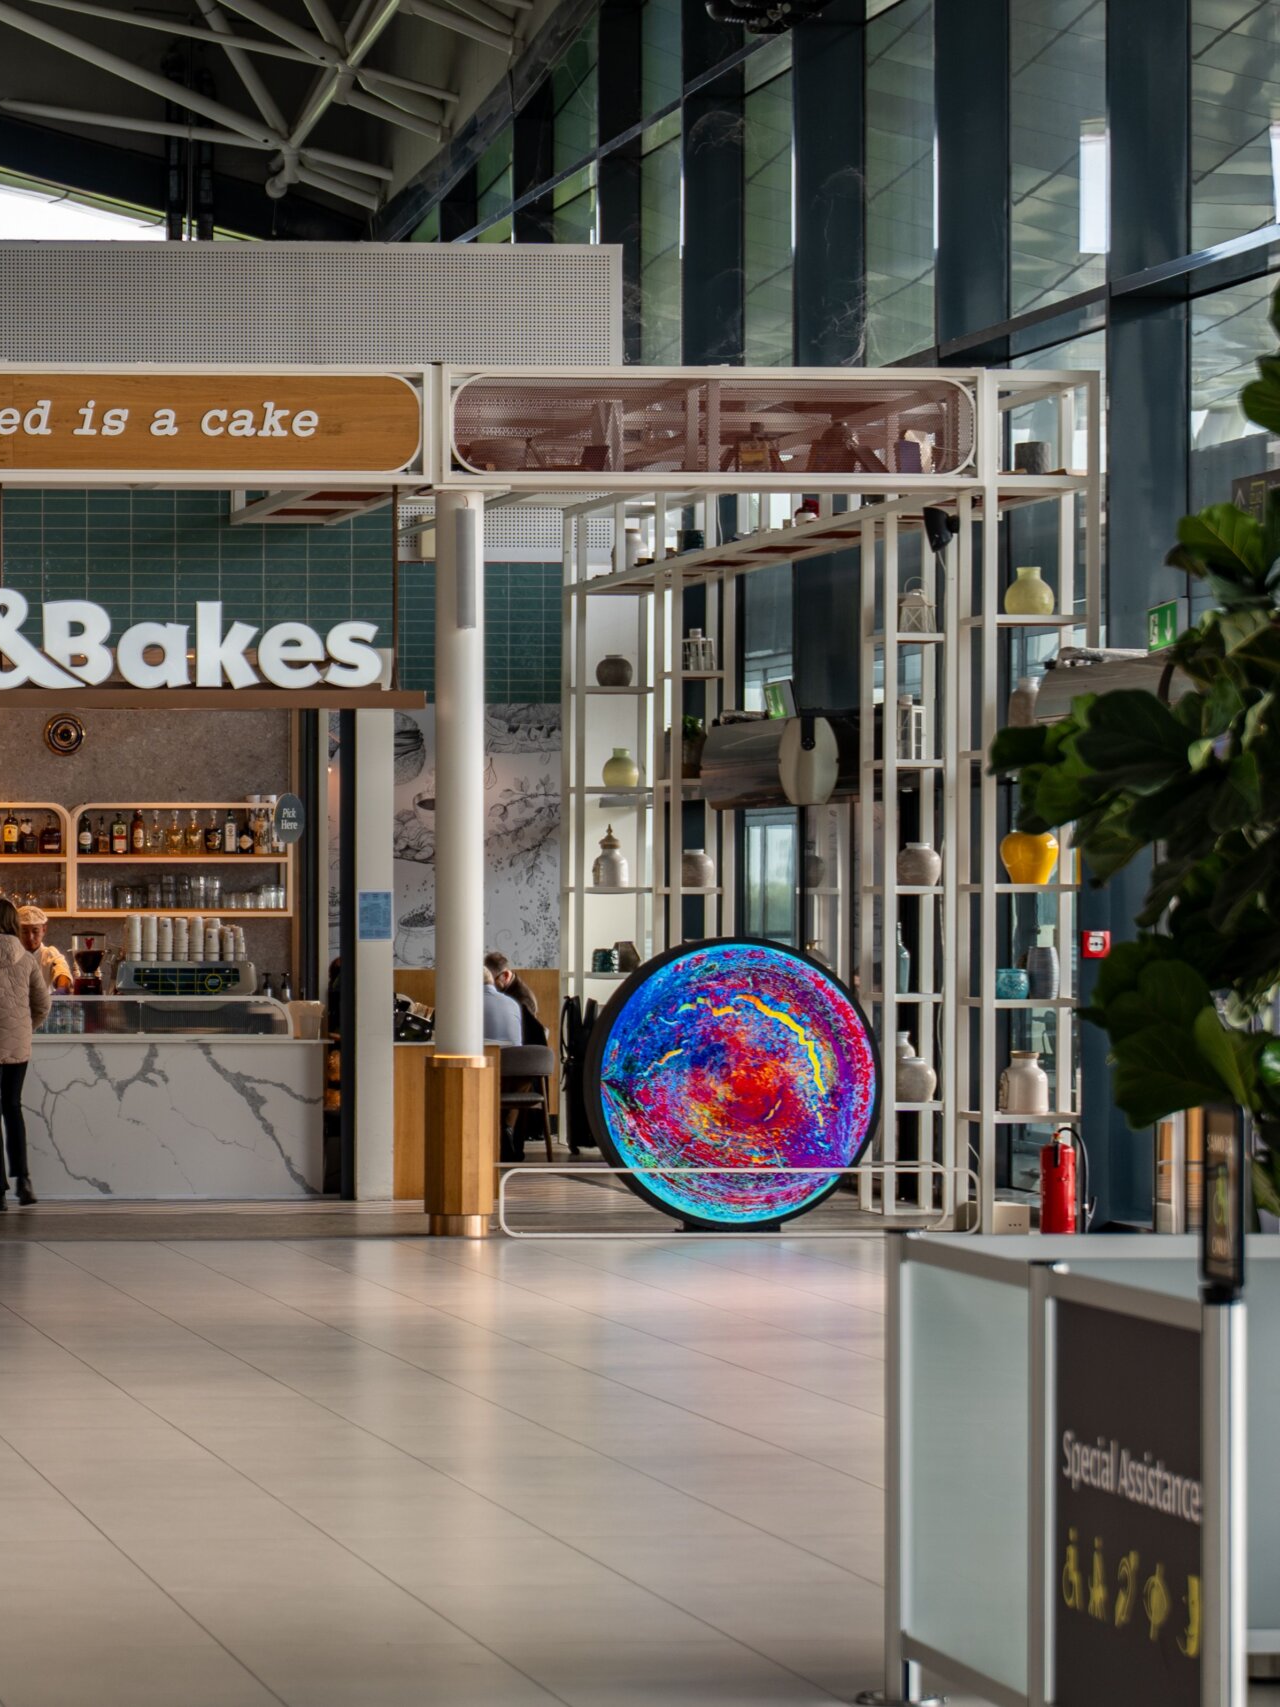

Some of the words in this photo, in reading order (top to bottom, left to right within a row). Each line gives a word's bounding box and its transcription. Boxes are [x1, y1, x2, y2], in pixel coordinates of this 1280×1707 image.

[73, 399, 129, 436] is
[150, 408, 179, 436] a
[201, 401, 319, 438] cake
[281, 819, 298, 830] Here
[282, 808, 296, 818] Pick
[1062, 1430, 1119, 1492] Special
[1117, 1448, 1202, 1525] Assistance
